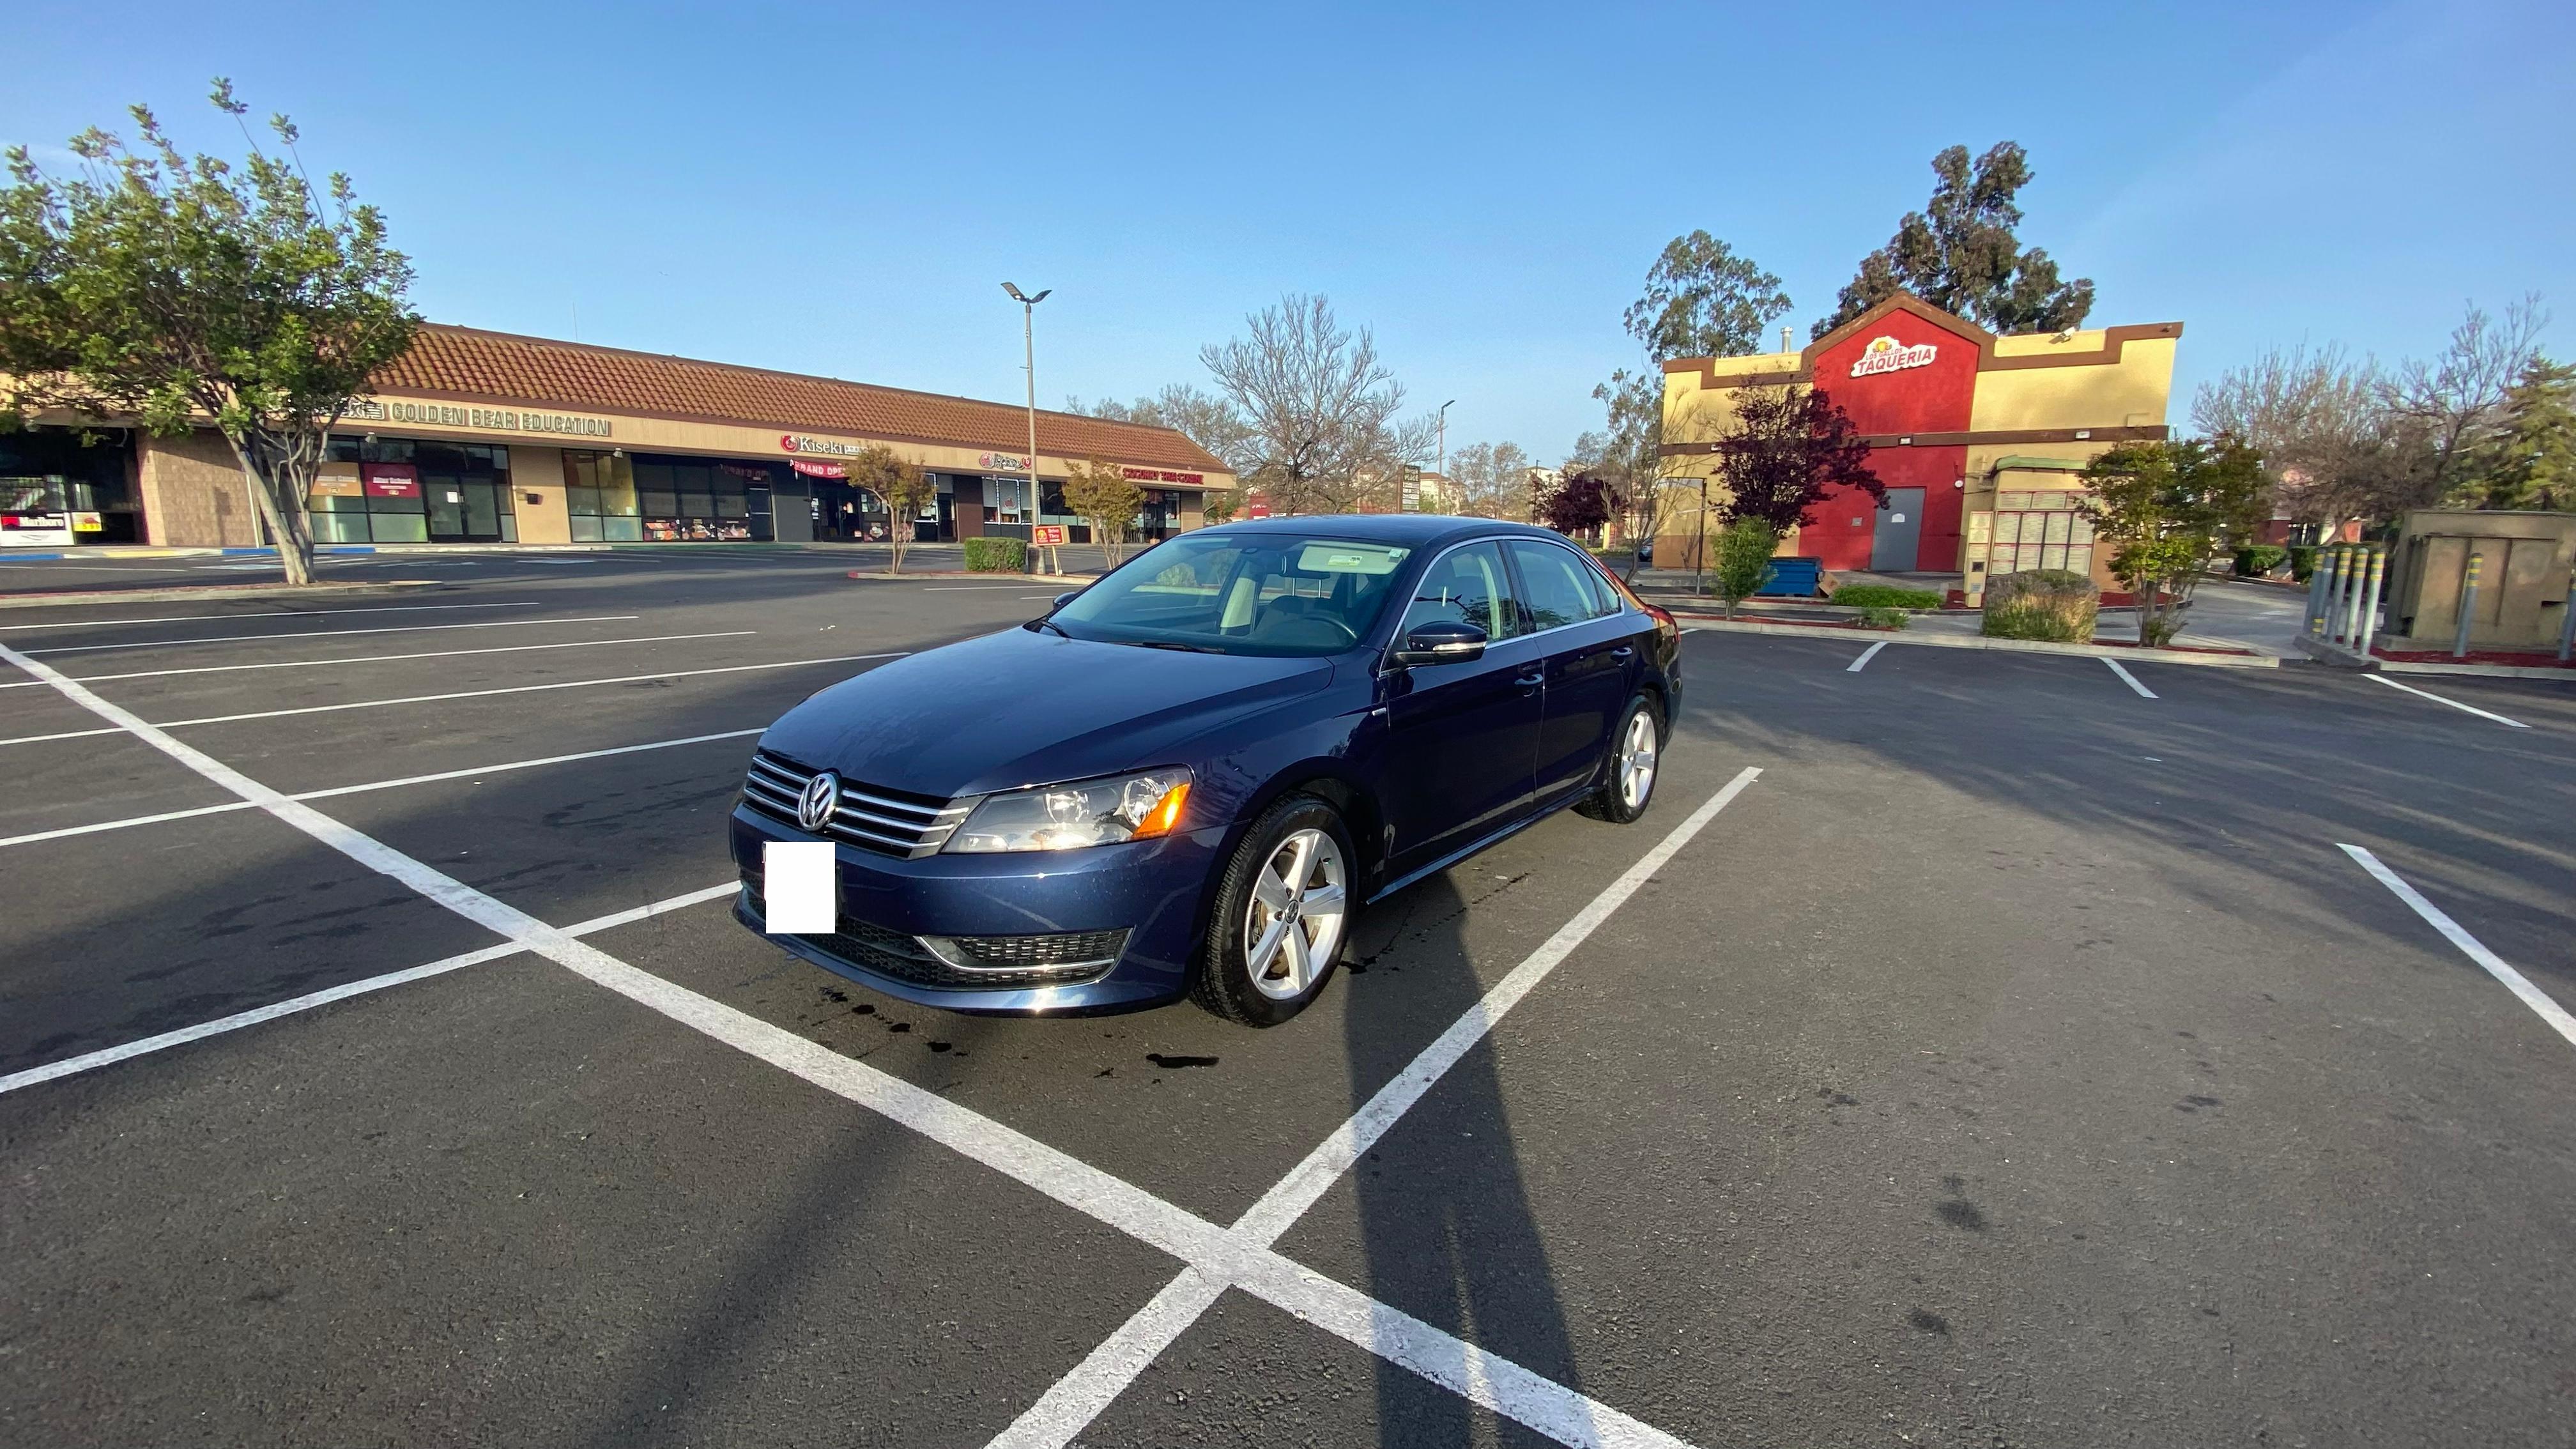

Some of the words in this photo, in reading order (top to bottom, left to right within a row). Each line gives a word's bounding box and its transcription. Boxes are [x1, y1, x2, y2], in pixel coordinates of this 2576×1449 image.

[1858, 348, 1931, 374] TAQUERIA
[1879, 348, 1903, 358] GALLOS
[391, 402, 465, 426] GOLDEN
[470, 408, 516, 430] BEAR
[520, 413, 610, 437] EDUCATION
[799, 436, 843, 455] Kiseki
